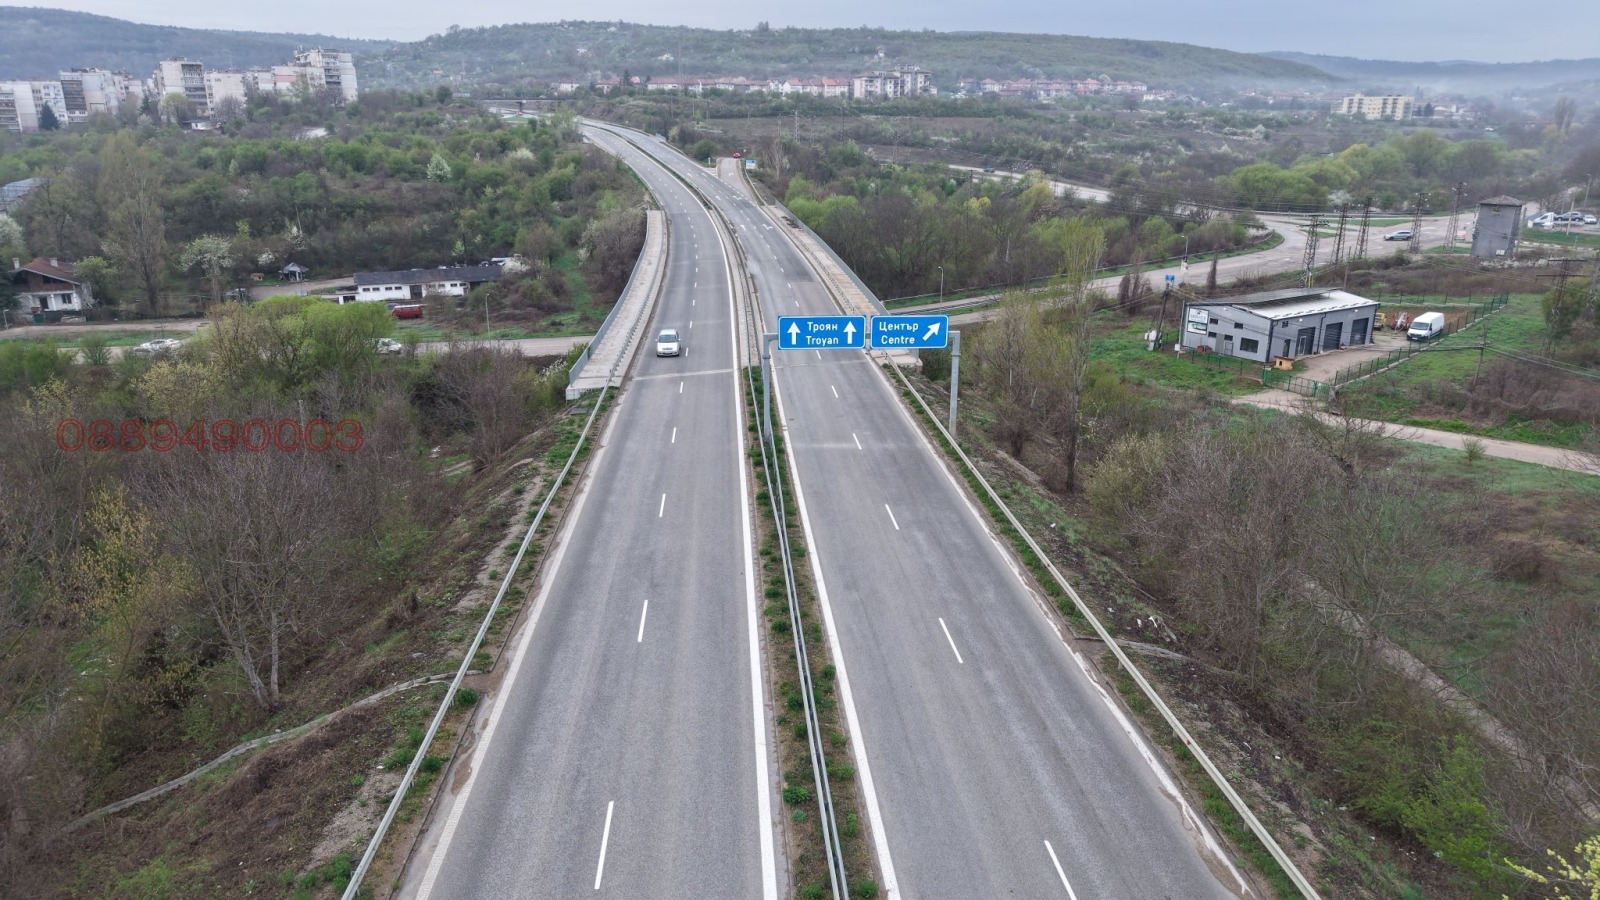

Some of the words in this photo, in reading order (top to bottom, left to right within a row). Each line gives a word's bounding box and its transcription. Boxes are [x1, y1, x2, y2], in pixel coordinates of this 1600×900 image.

[807, 321, 838, 333] Троян
[879, 321, 919, 333] Център
[806, 335, 839, 346] Troyan
[881, 335, 915, 345] Centre
